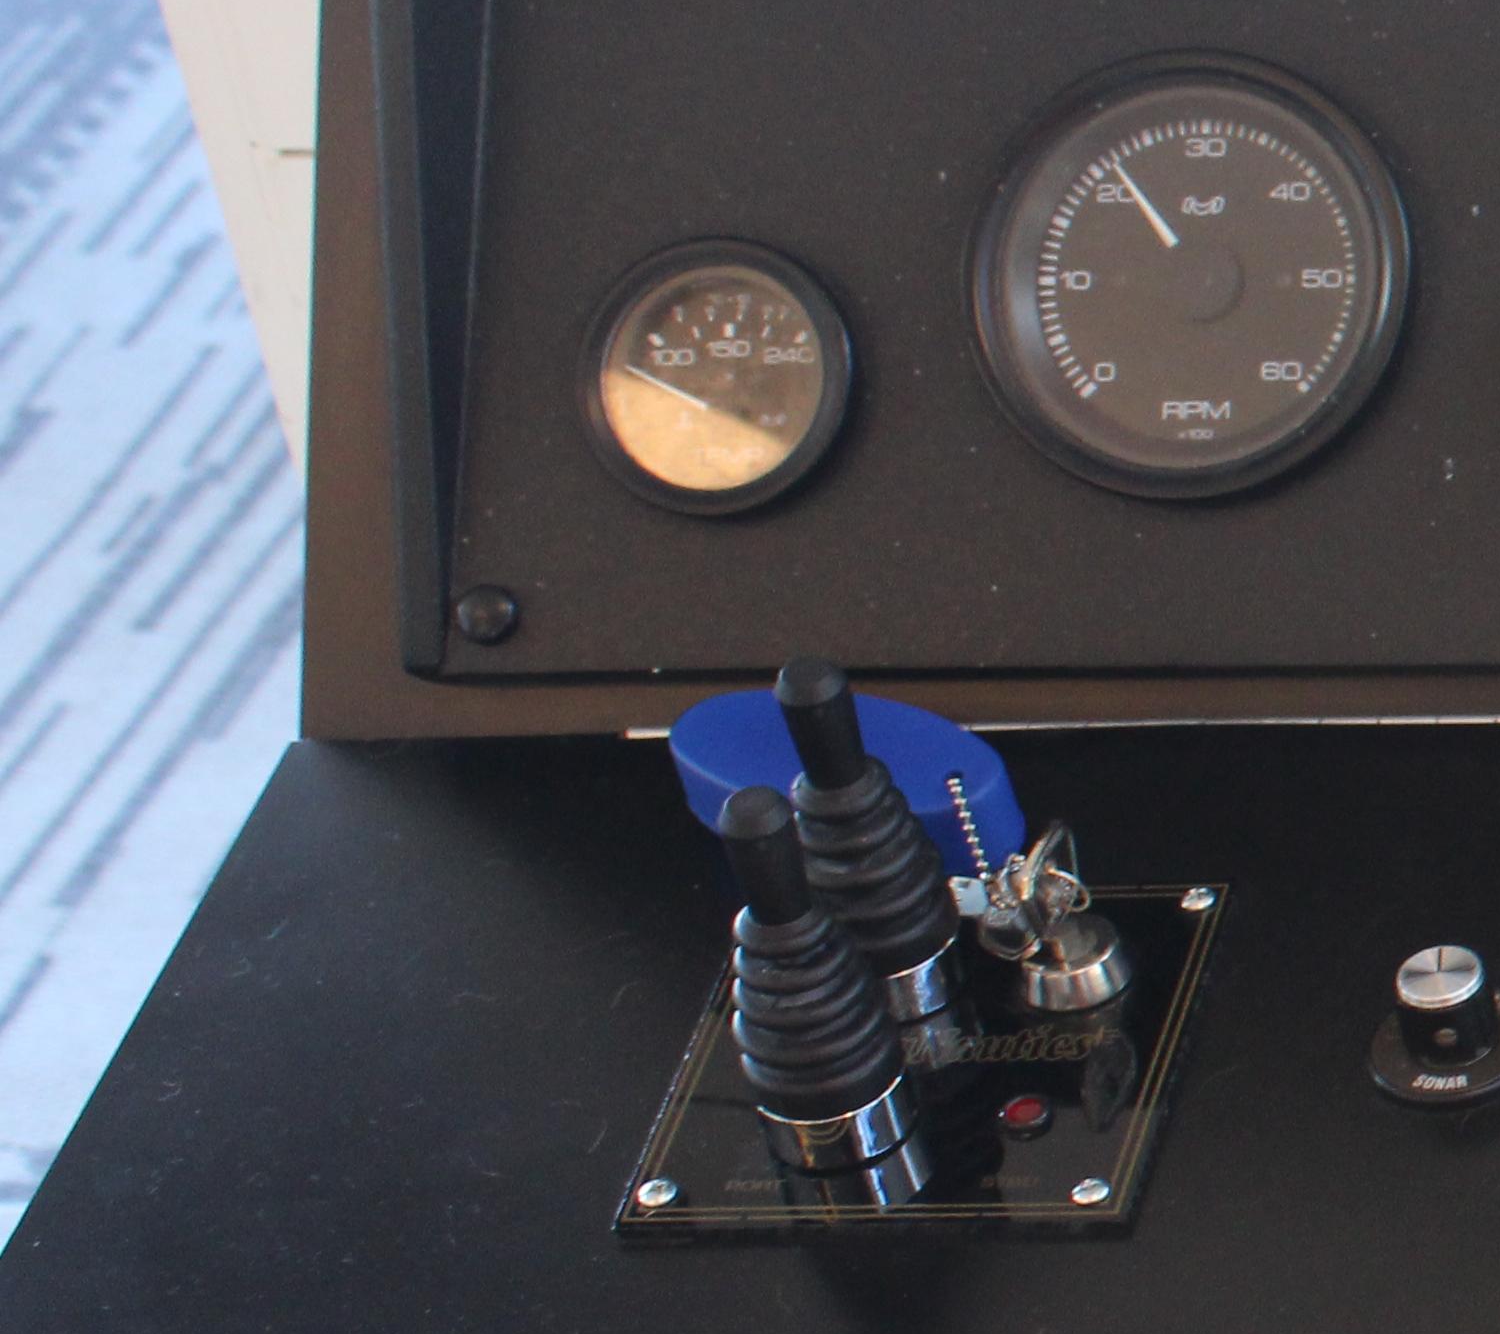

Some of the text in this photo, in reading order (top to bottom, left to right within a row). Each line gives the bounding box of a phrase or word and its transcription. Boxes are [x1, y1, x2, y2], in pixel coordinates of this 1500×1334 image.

[1185, 137, 1228, 158] 30
[1096, 184, 1136, 204] 20
[1269, 182, 1312, 202] 40
[1060, 269, 1093, 291] 10
[1301, 268, 1344, 289] 50
[1095, 363, 1117, 383] 0
[1260, 362, 1303, 382] 60
[1161, 400, 1232, 421] RPM
[1411, 1073, 1468, 1091] SONAR
